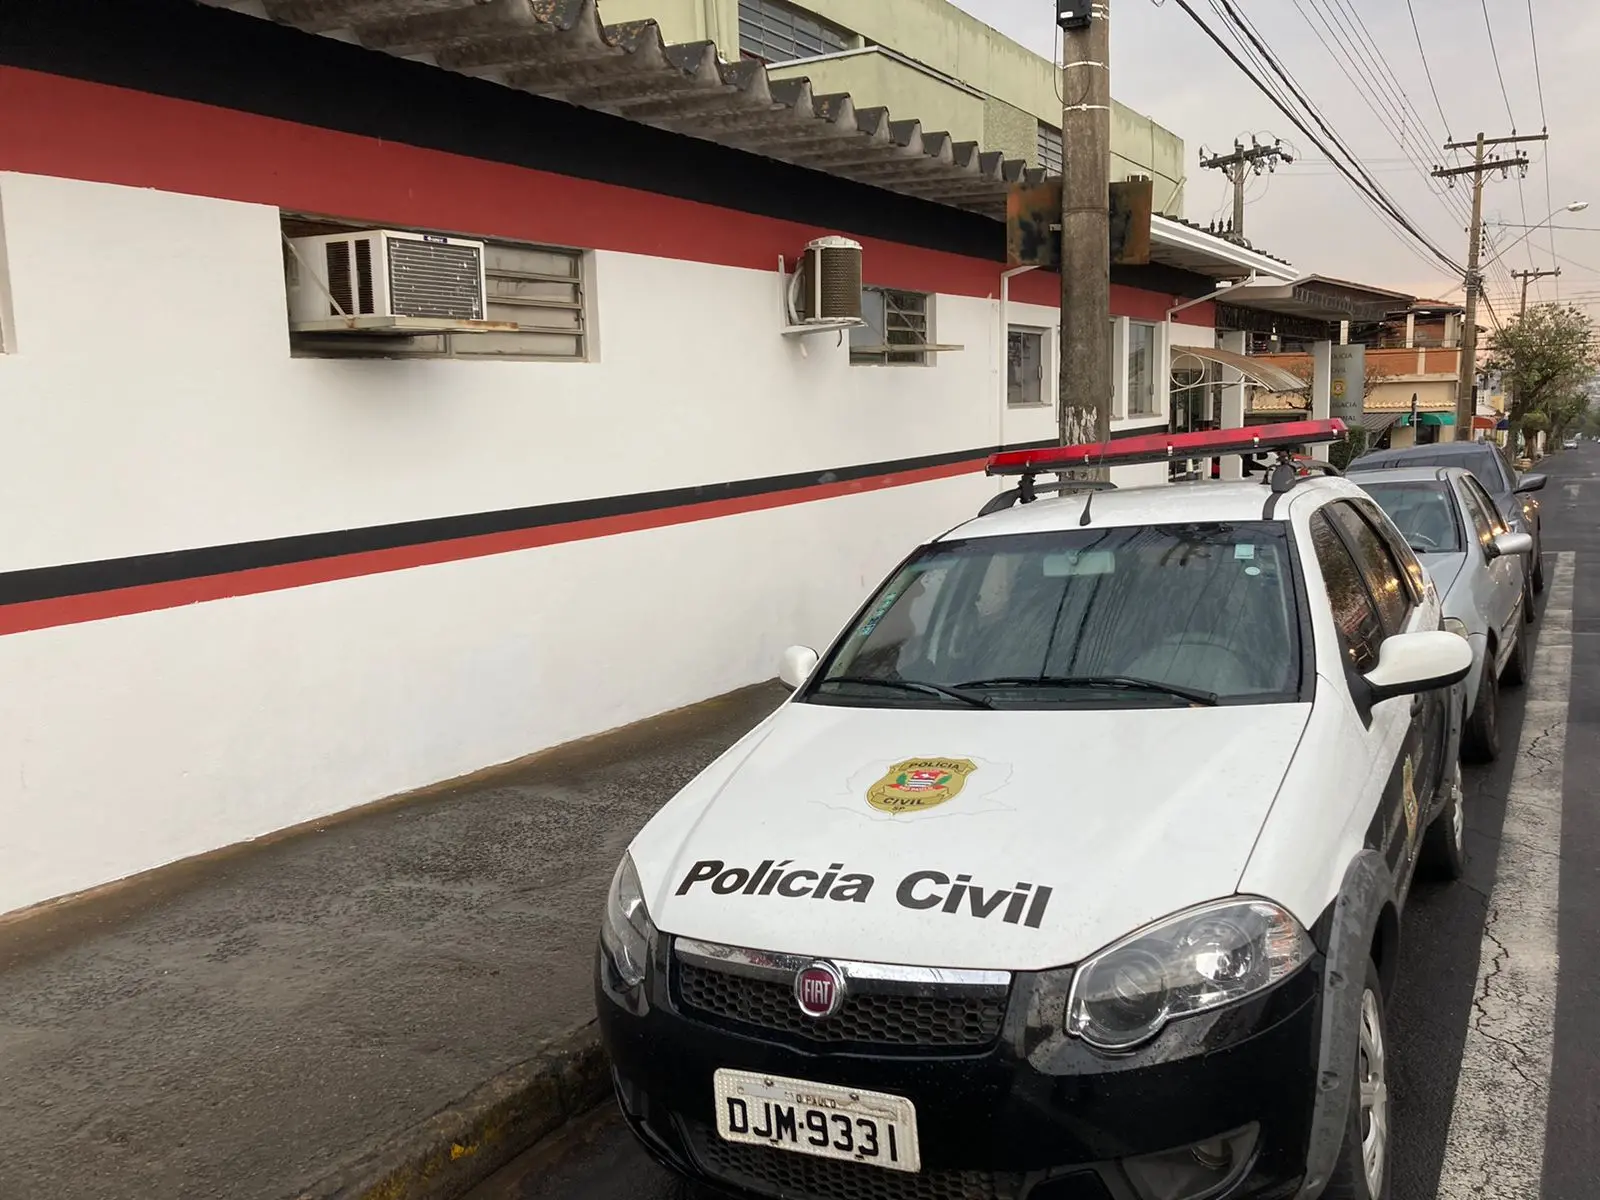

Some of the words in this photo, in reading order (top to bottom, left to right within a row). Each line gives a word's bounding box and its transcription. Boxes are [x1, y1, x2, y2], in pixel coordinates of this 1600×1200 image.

[883, 797, 925, 805] CIVIL
[675, 859, 875, 903] Polícia
[895, 870, 1053, 929] Civil
[804, 979, 831, 1005] FIAT
